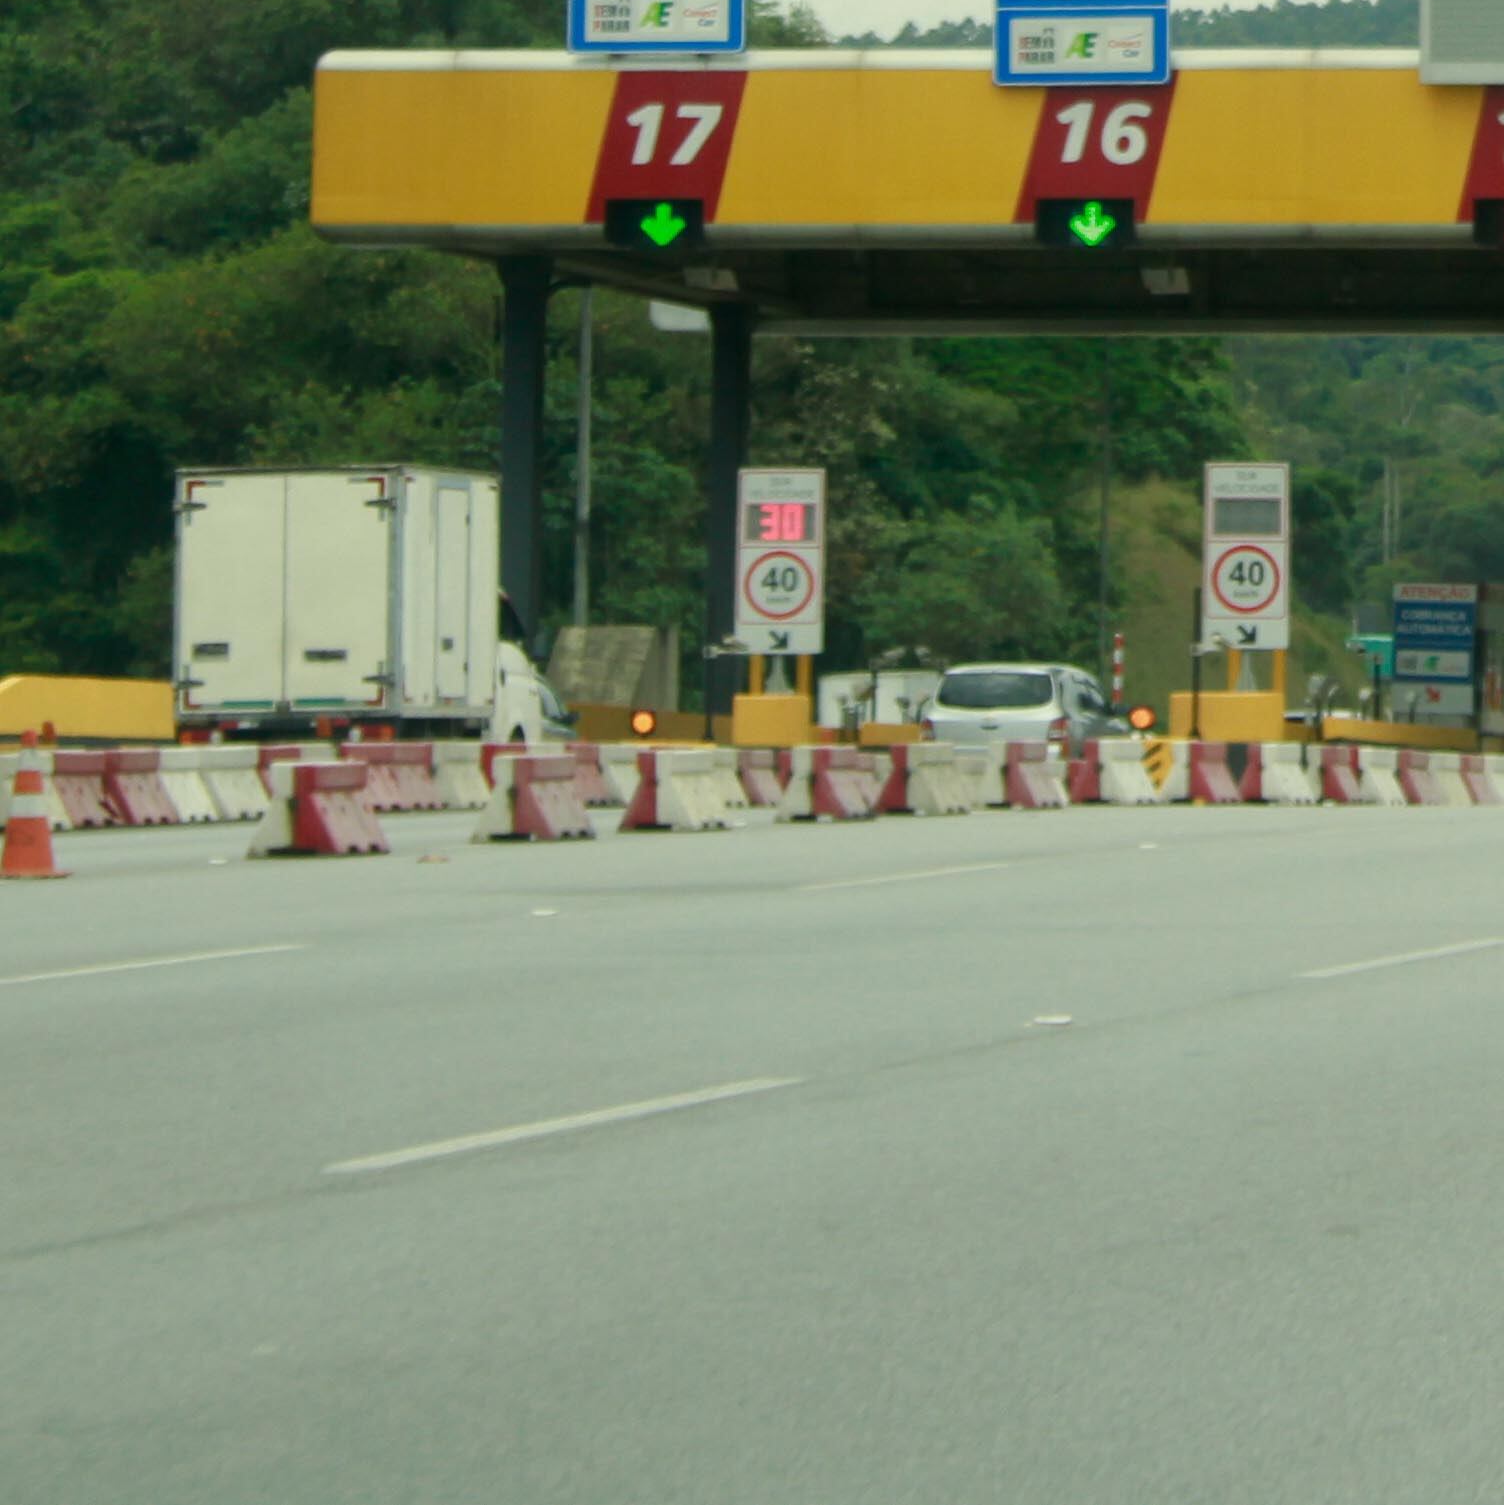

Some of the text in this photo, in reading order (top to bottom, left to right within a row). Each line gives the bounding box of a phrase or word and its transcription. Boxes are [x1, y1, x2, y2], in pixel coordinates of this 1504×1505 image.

[627, 104, 722, 165] 17
[1056, 102, 1151, 165] 16
[758, 502, 806, 543] 30
[761, 565, 799, 593] 40
[1228, 560, 1265, 587] 40
